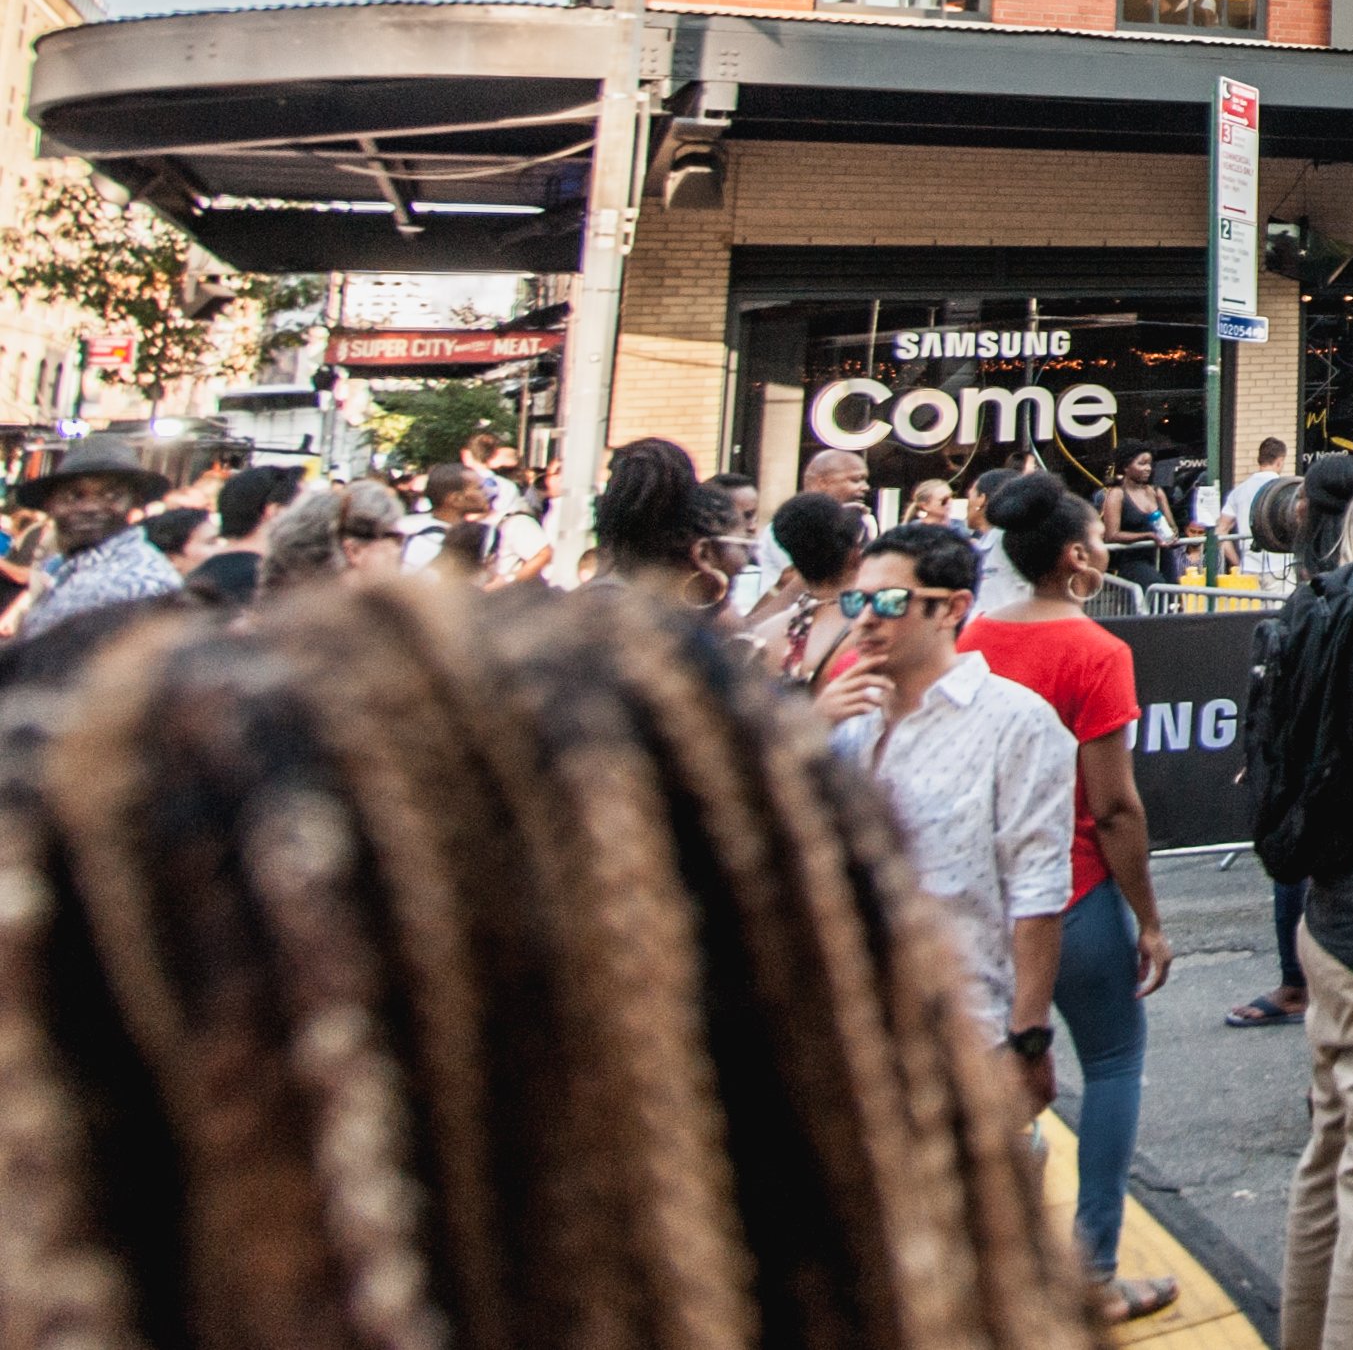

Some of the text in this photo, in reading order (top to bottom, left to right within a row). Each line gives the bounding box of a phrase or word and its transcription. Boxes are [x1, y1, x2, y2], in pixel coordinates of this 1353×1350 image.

[1222, 123, 1231, 143] 3
[1222, 219, 1230, 239] 2
[350, 338, 409, 358] SUPER
[411, 338, 456, 357] CITY
[493, 337, 541, 357] MEAT
[895, 330, 1071, 359] SAMSUNG
[812, 377, 1118, 451] Come
